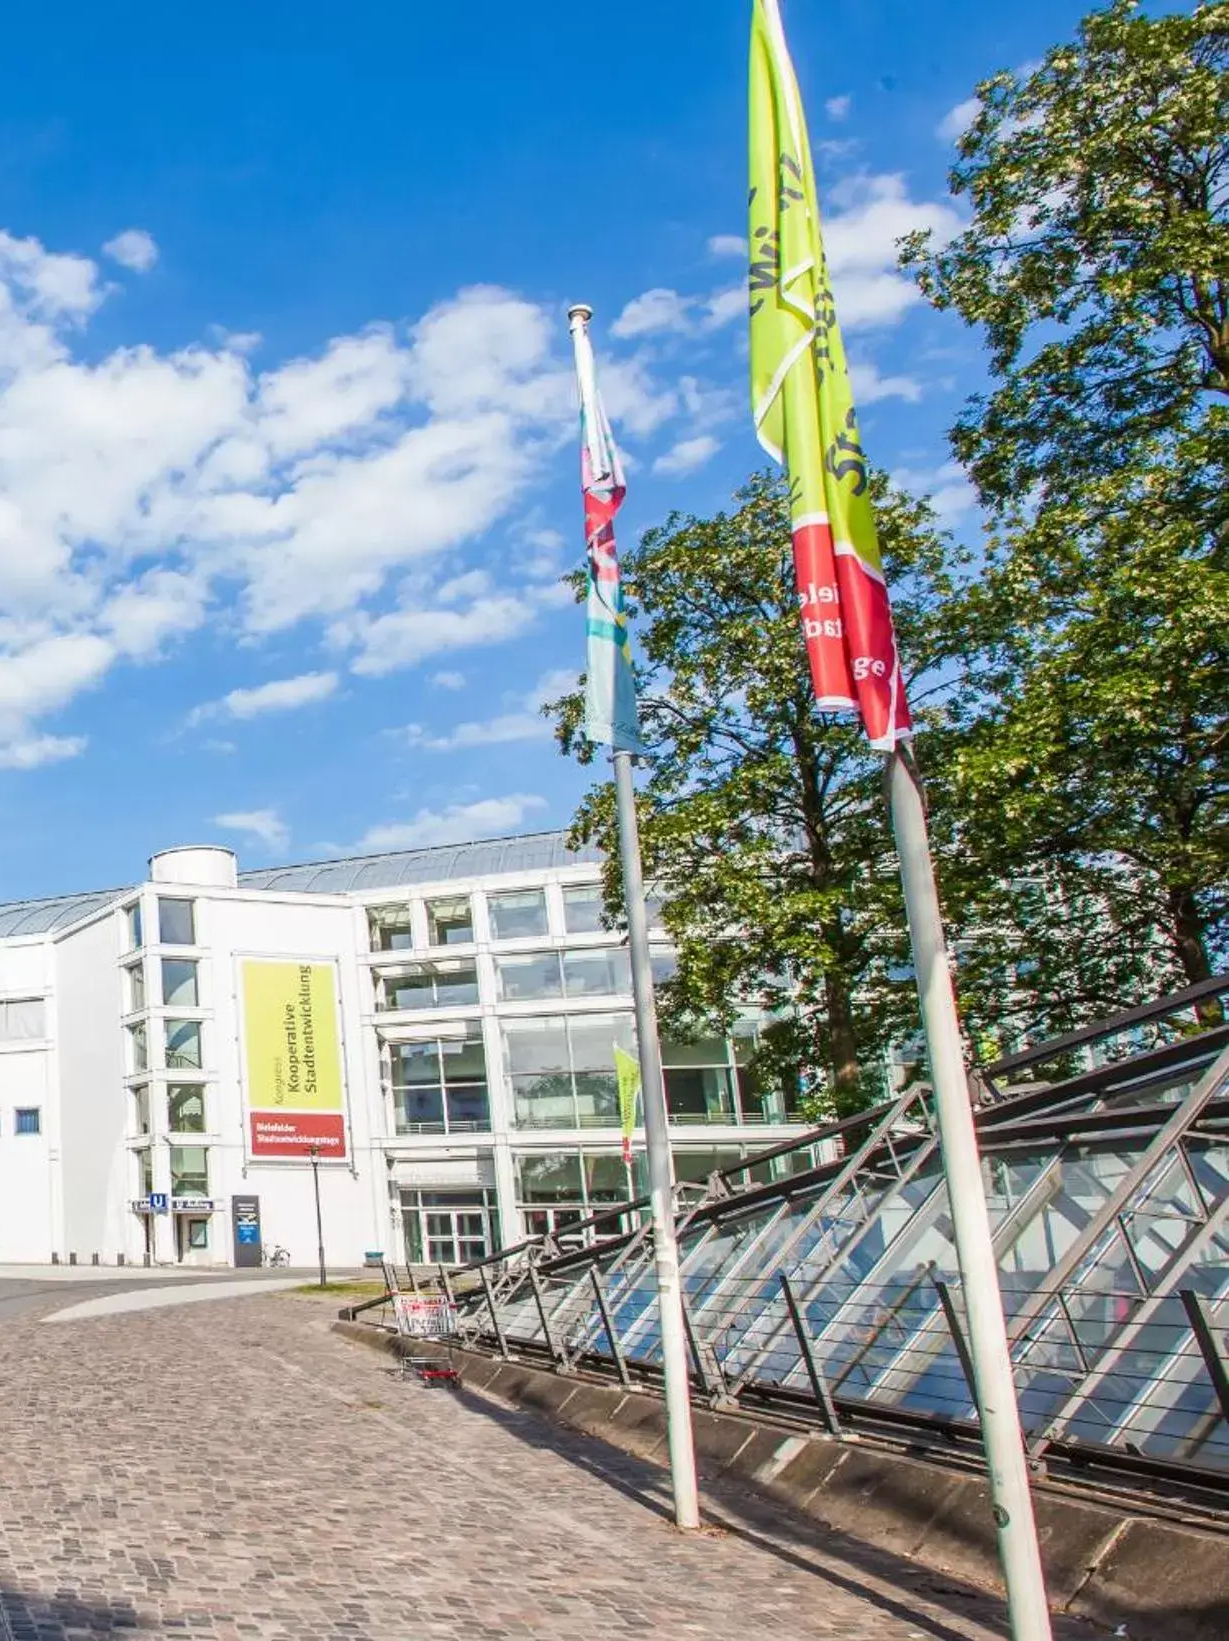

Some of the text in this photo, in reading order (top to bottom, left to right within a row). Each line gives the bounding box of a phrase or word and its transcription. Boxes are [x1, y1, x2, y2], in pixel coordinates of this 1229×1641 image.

[282, 1003, 300, 1093] Kooperative
[299, 964, 317, 1094] Stadtentwicklung
[153, 1195, 163, 1207] U
